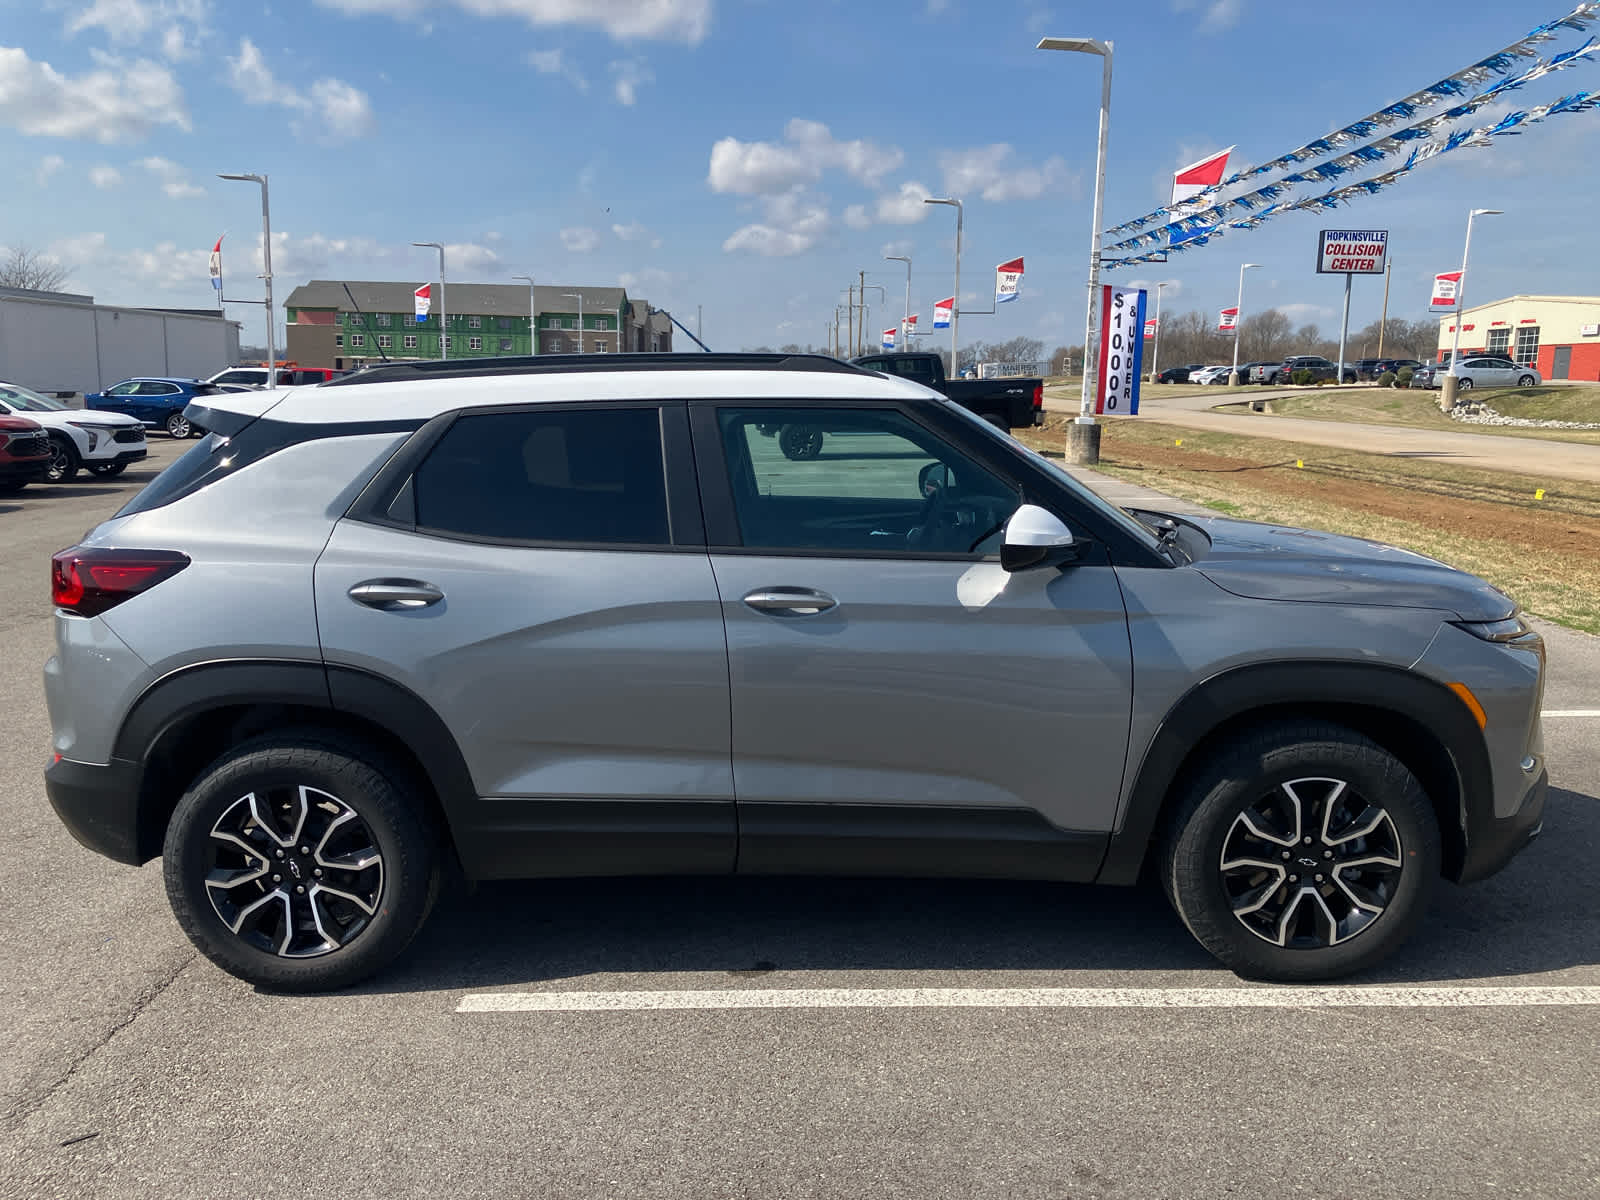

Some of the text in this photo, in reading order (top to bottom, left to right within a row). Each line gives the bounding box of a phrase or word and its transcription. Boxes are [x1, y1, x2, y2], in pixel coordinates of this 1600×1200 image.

[1327, 232, 1385, 242] HOPKINSVILLE
[1325, 243, 1384, 256] COLLISION
[1331, 258, 1375, 270] CENTER
[1123, 306, 1136, 399] & UNDER
